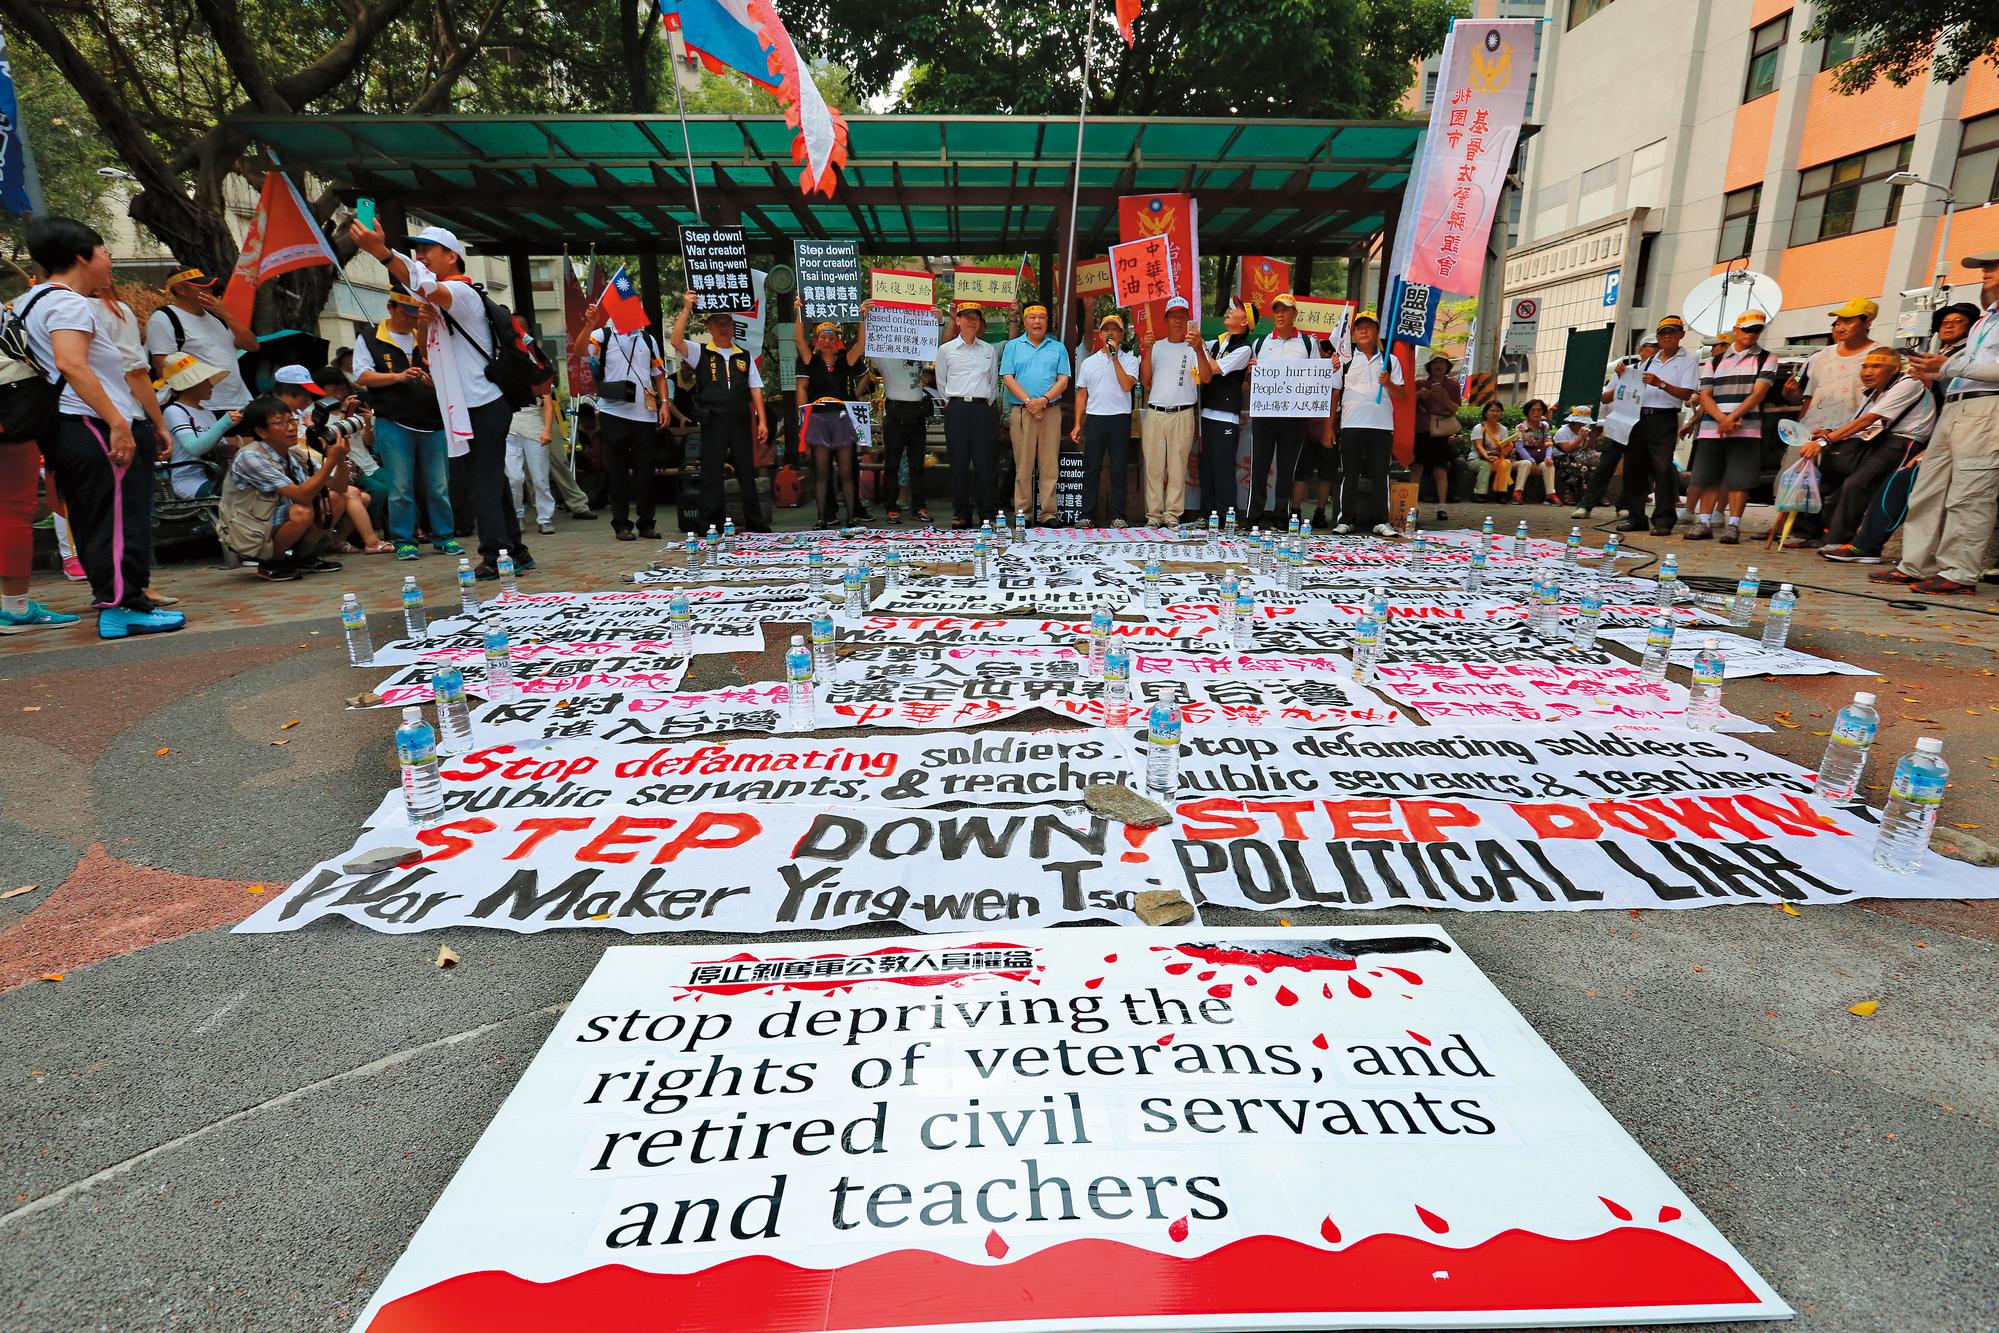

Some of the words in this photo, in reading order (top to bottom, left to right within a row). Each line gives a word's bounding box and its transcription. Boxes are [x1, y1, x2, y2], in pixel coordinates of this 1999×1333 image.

[685, 230, 711, 244] Step
[713, 229, 742, 242] down!
[686, 245, 706, 256] War
[708, 244, 746, 256] creator!
[800, 245, 824, 256] Step
[826, 244, 854, 255] down!
[689, 259, 708, 270] Tsai
[710, 258, 747, 271] ing-wen!
[800, 257, 821, 268] Poor
[823, 257, 857, 268] creator!
[1145, 242, 1168, 298] 中華隊
[692, 273, 748, 290] 戰爭製造者
[801, 270, 820, 281] Tsai
[821, 271, 858, 283] ing-wen!
[1117, 256, 1141, 298] 加油
[1607, 273, 1619, 294] P
[803, 286, 858, 301] 貧窮製造者
[874, 279, 932, 296] 恢復恩給
[696, 292, 752, 310] 蔡英文下台
[806, 302, 860, 318] 蔡英文下台
[867, 312, 891, 323] Based
[867, 322, 917, 334] Expectation
[1253, 366, 1281, 378] Stop
[1285, 366, 1332, 378] hurting
[1252, 381, 1292, 396] People's
[1295, 382, 1330, 396] dignity
[1060, 457, 1083, 467] down
[1060, 470, 1085, 478] creator
[1056, 482, 1083, 491] ng-wen
[1003, 589, 1132, 603] hurting
[863, 617, 1008, 631] STEP
[836, 626, 907, 641] War
[914, 630, 1036, 643] Maker
[864, 660, 1088, 680] 進入台灣
[542, 708, 782, 740] 進入台灣
[1293, 731, 1539, 767] defamating
[1536, 729, 1750, 763] soldiers,
[437, 744, 600, 783] Stop
[614, 745, 899, 778] defamating
[1178, 763, 1317, 793] ublic
[1540, 771, 1579, 797] &
[441, 781, 612, 812] public
[626, 773, 869, 807] servants,
[880, 768, 930, 800] &
[1176, 799, 1481, 843] STEP
[399, 812, 764, 870] STEP
[791, 811, 1161, 865] DOWN!
[1171, 838, 1605, 905] POLITICAL
[1599, 839, 1855, 901] LIAR
[278, 867, 463, 924] War
[465, 866, 751, 923] Maker
[777, 863, 1040, 923] Ying-wen
[1042, 860, 1160, 911] Tsa
[577, 1012, 732, 1053] stop
[757, 994, 1111, 1045] depriving
[1121, 988, 1237, 1027] the
[584, 1054, 815, 1114] rights
[851, 1042, 928, 1090] of
[965, 1036, 1323, 1083] veterans,
[1349, 1034, 1497, 1078] and
[590, 1102, 890, 1171] retired
[920, 1091, 1092, 1148] civil
[1142, 1091, 1498, 1137] servants
[606, 1174, 787, 1250] and
[832, 1158, 1230, 1231] teachers
